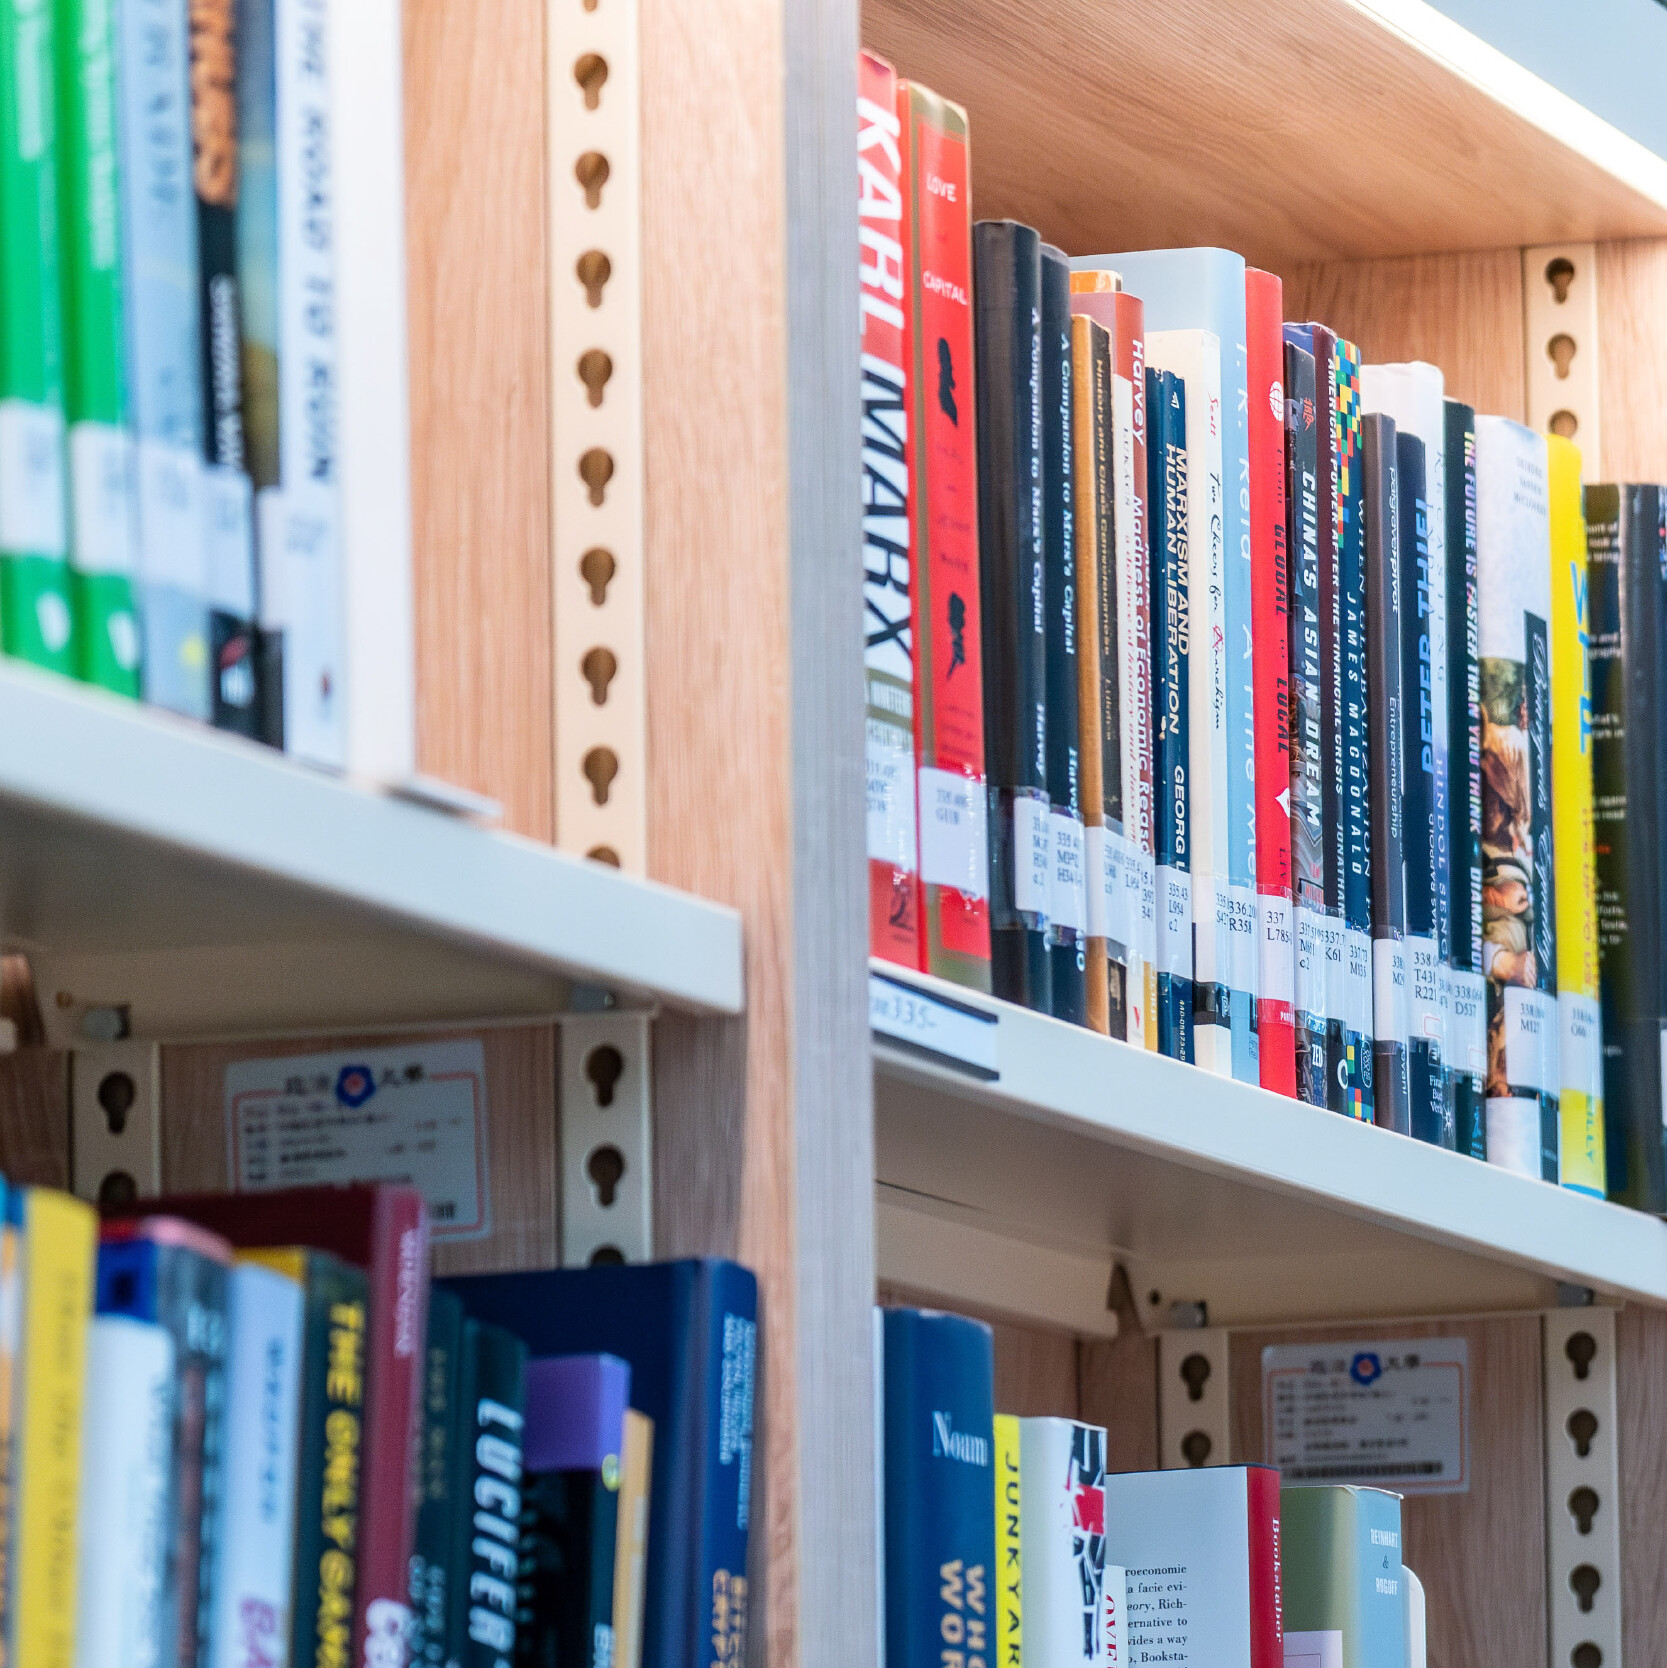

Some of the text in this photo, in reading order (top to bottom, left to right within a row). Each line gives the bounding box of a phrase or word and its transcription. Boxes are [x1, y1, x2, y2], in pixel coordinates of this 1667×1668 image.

[857, 97, 905, 336] KARL
[925, 172, 957, 203] LOVE
[922, 269, 969, 306] CAPITAL
[1132, 339, 1144, 446] Harvey
[1208, 390, 1220, 437] Scott
[861, 352, 913, 683] MARX
[1060, 360, 1075, 656] Companion Marx's Capital
[1175, 447, 1190, 656] MARXISM AND
[1273, 523, 1288, 616] GLOBAL
[1133, 495, 1149, 773] Madness Economic
[1165, 442, 1180, 735] HUMAN LIBERATION
[1210, 513, 1226, 731] Cheers Anarchism
[1327, 357, 1344, 796] AMERICAN POWER AFTER THE FINANCIAL CRISIS
[1415, 498, 1434, 775] PETER THIEL
[1463, 431, 1482, 835] THE FUTURE IS FASTER THAN YOU THINK
[1300, 470, 1322, 828] CHINA'S ASIAN DREAM
[1346, 591, 1363, 876] JAMES MACDONALD
[1388, 696, 1400, 839] Entrepreneurship
[1174, 764, 1186, 855] GEORG
[1266, 910, 1285, 925] 337
[326, 1299, 366, 1405] THE
[321, 1408, 361, 1549] ONLY
[931, 1409, 989, 1469] Noam
[1272, 1516, 1283, 1643] Bookstaber
[1370, 1527, 1399, 1549] REINHART
[1375, 1577, 1399, 1597] ROGOFF
[1140, 1650, 1189, 1664] Booksta-
[1158, 1597, 1188, 1611] Rich-
[1166, 1635, 1188, 1647] way
